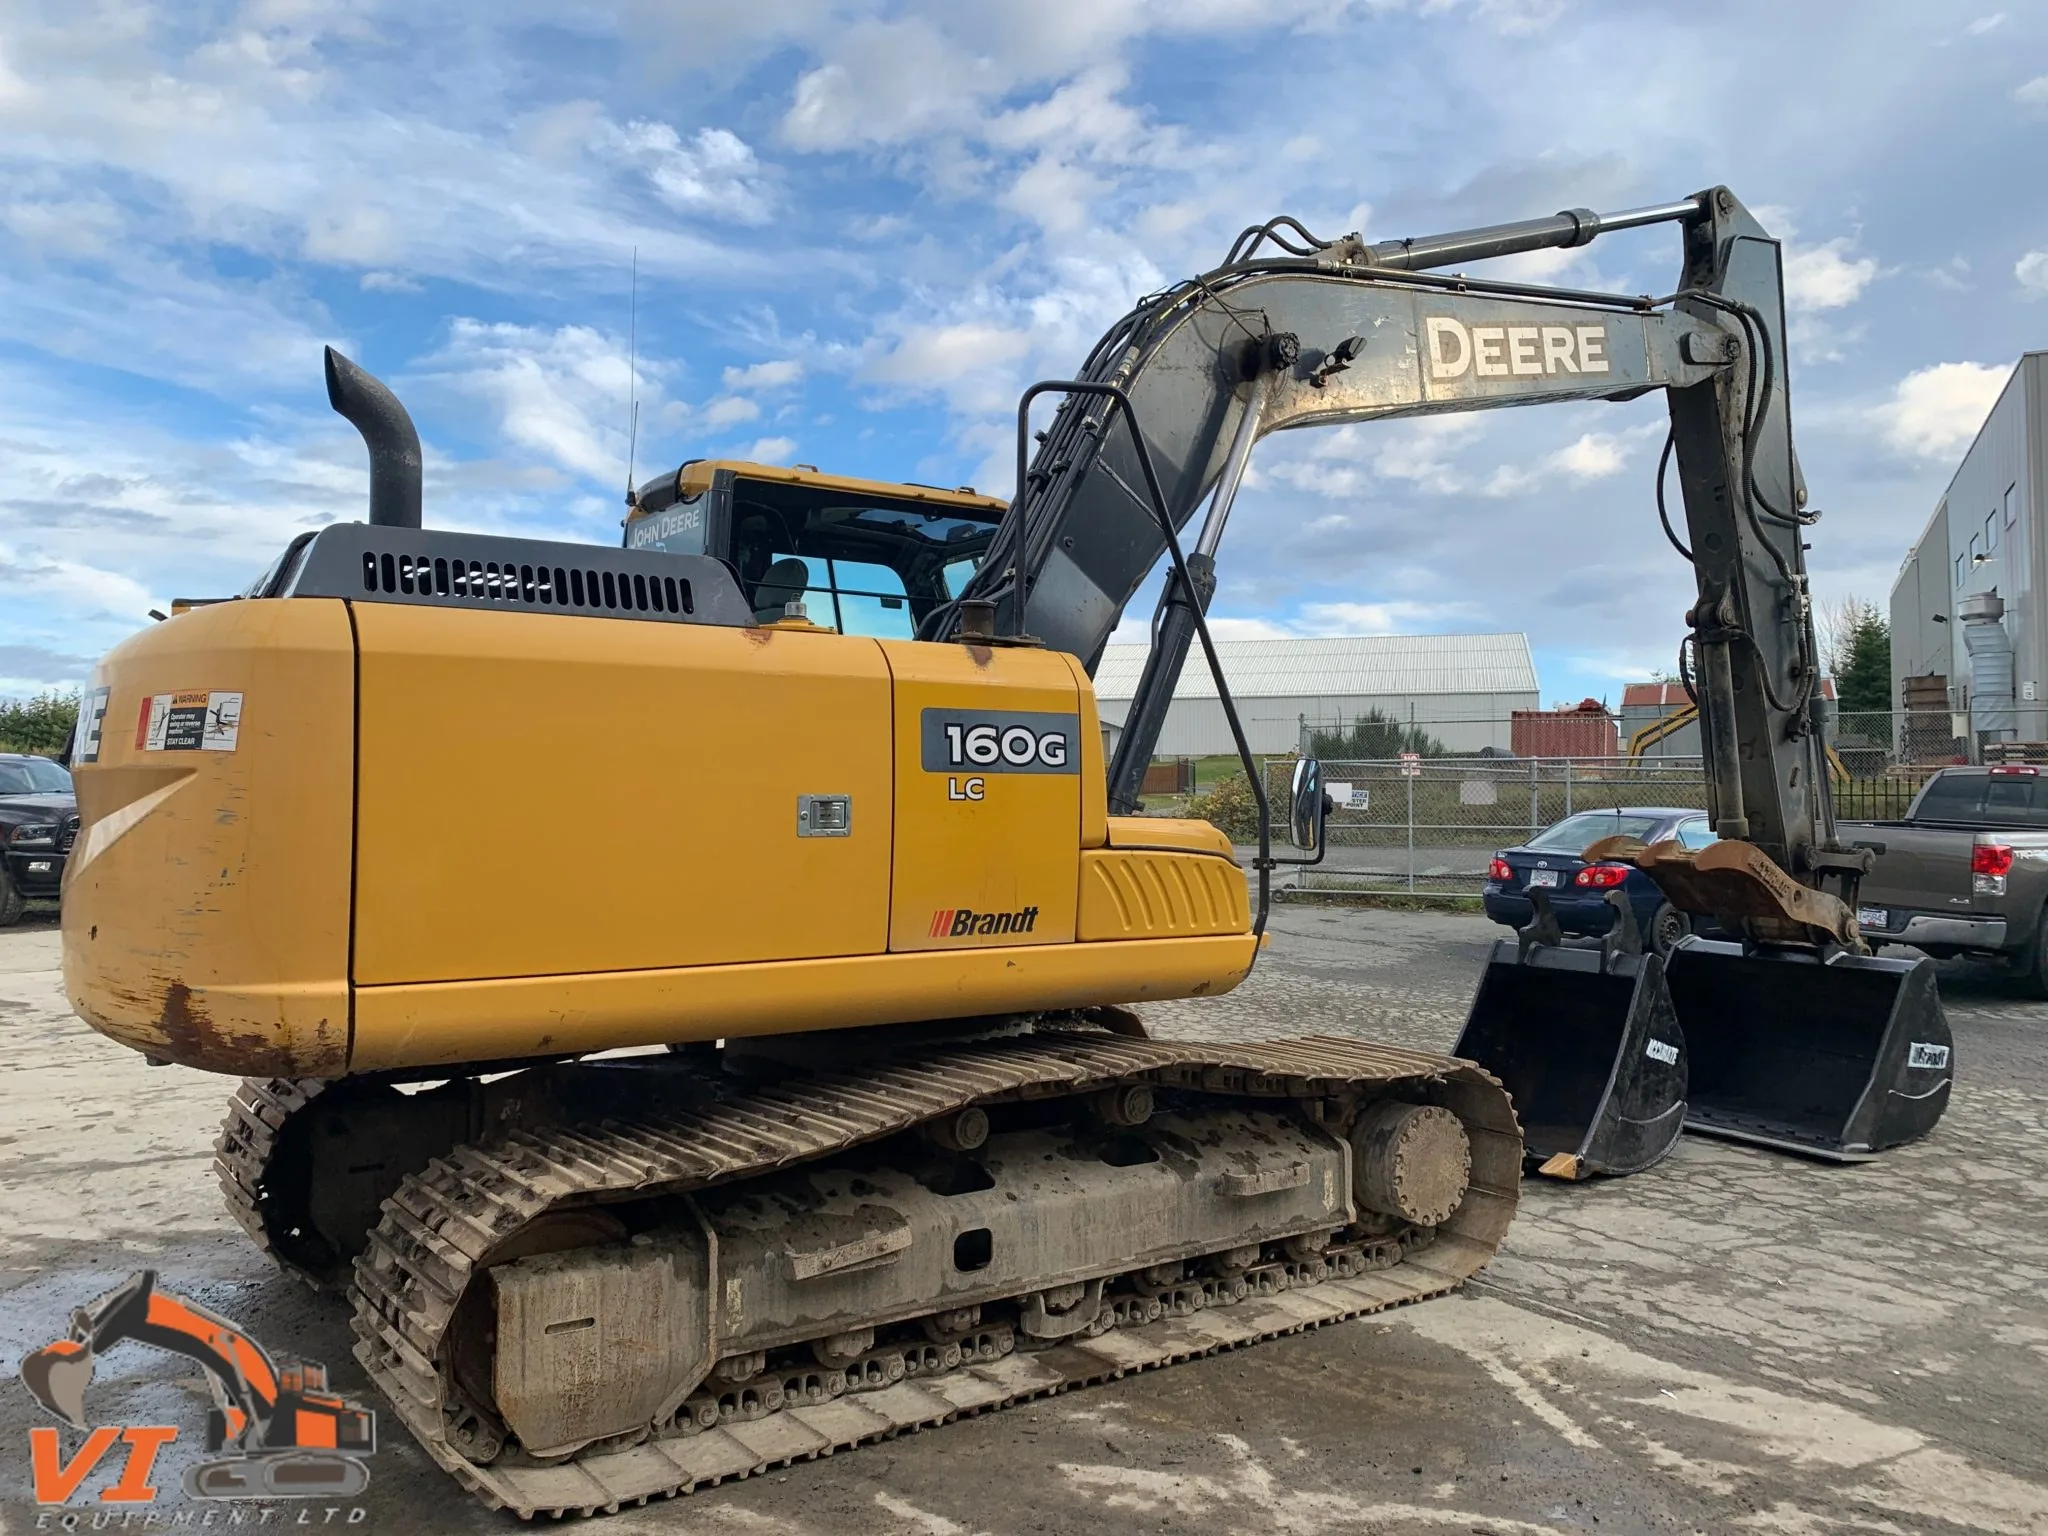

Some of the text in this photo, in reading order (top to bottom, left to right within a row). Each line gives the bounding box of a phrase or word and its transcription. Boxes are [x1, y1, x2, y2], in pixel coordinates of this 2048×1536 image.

[1426, 317, 1609, 378] DEERE
[630, 509, 699, 549] JOHN DEERE
[177, 693, 207, 704] WARNING
[166, 737, 195, 746] STAY CLEAR
[944, 723, 1067, 767] 160G
[948, 777, 985, 801] LC
[950, 906, 1039, 937] Brandt
